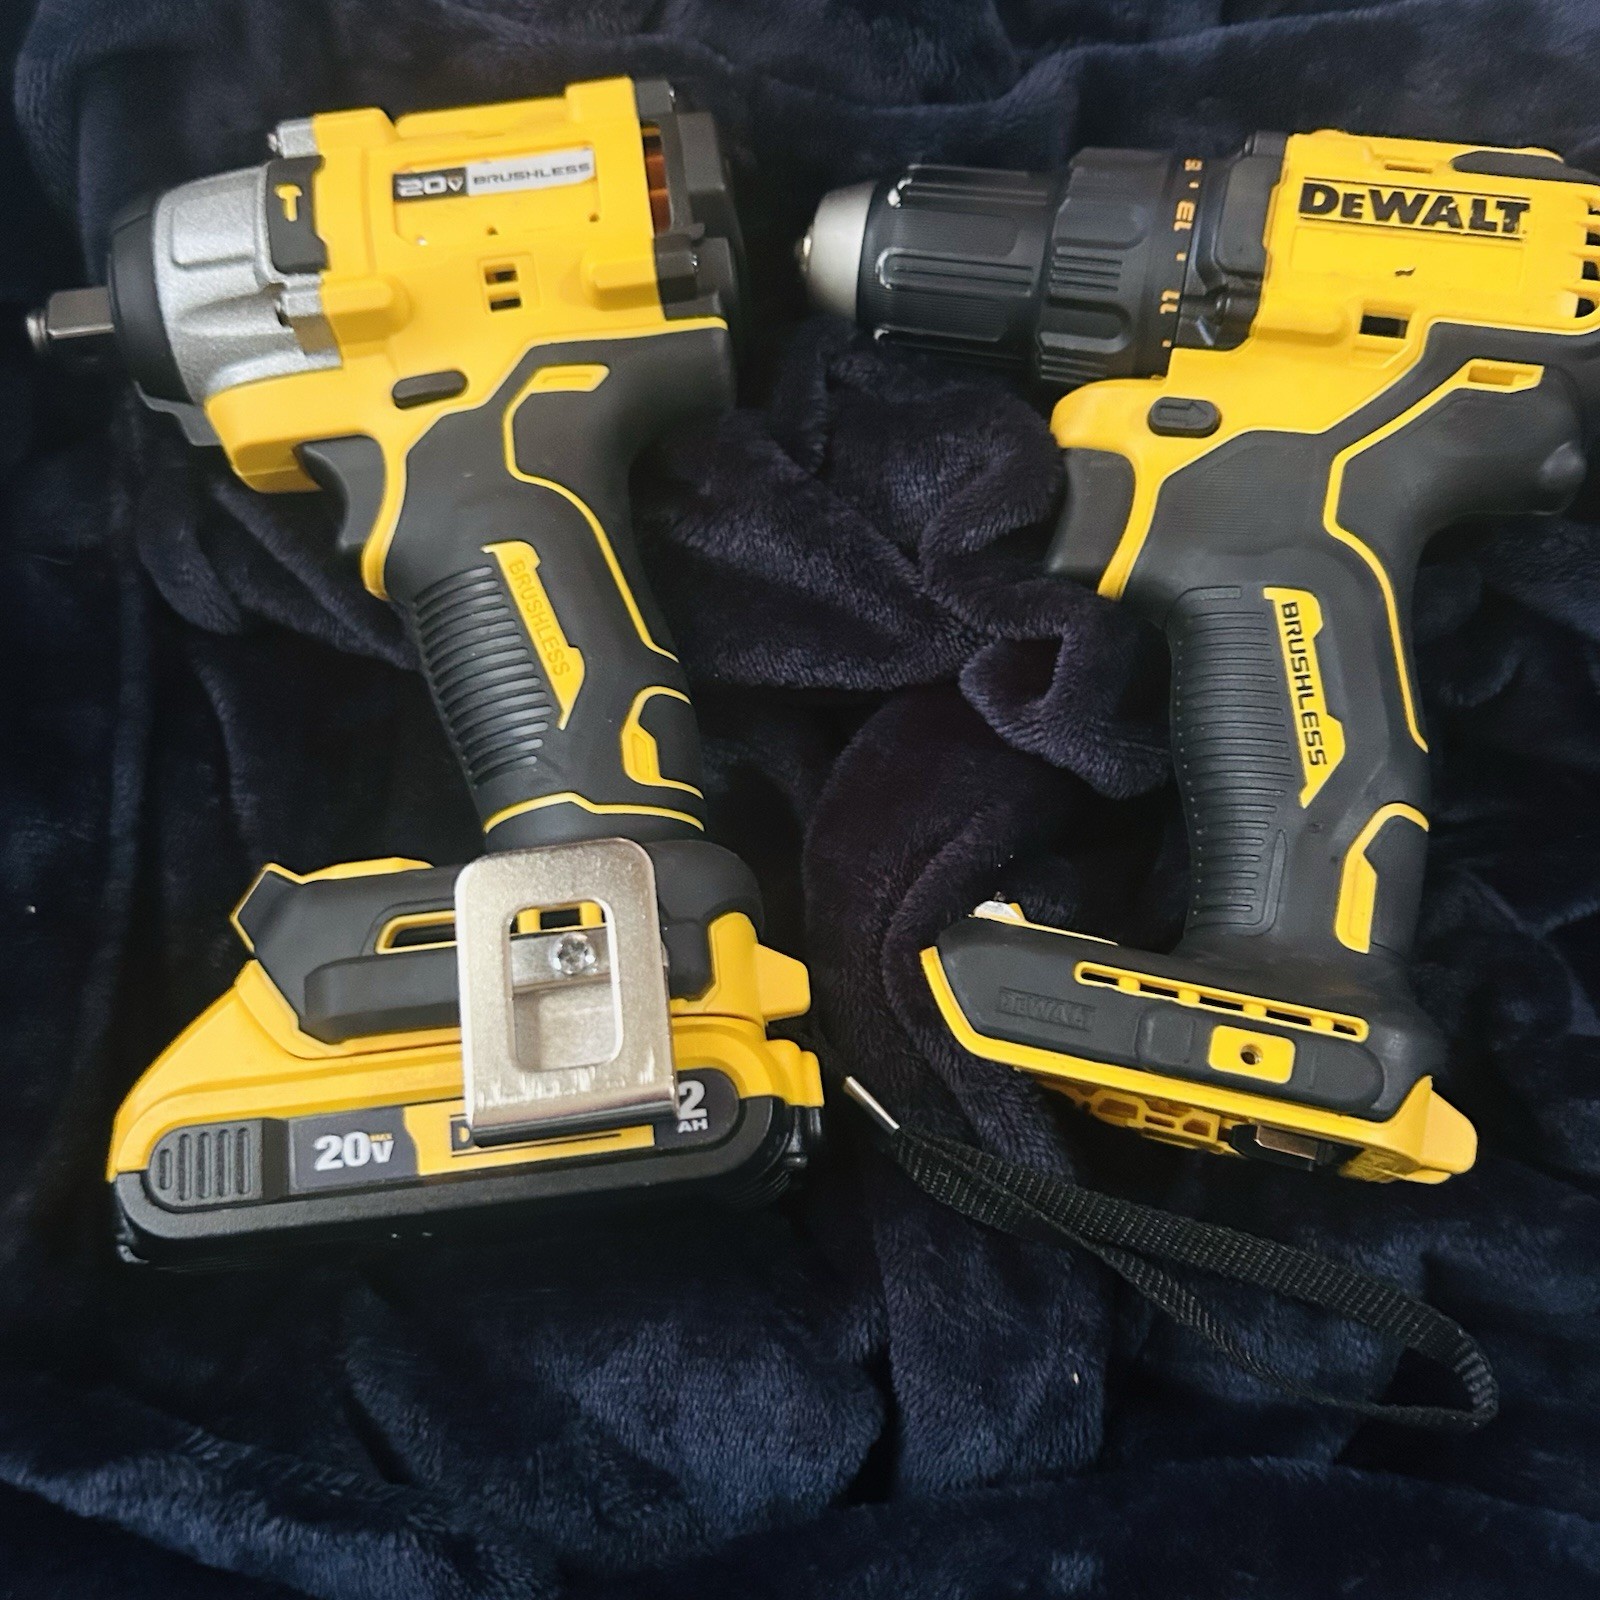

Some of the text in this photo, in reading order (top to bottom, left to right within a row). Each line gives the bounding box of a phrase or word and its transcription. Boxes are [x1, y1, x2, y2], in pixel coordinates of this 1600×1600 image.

[472, 162, 590, 186] BRUSHLESS
[1173, 200, 1196, 231] 13
[1160, 289, 1181, 314] 11
[508, 559, 571, 677] BRUSHLESS
[1281, 601, 1327, 766] BRUSHLESS
[677, 1080, 708, 1119] 2
[677, 1118, 709, 1134] AH
